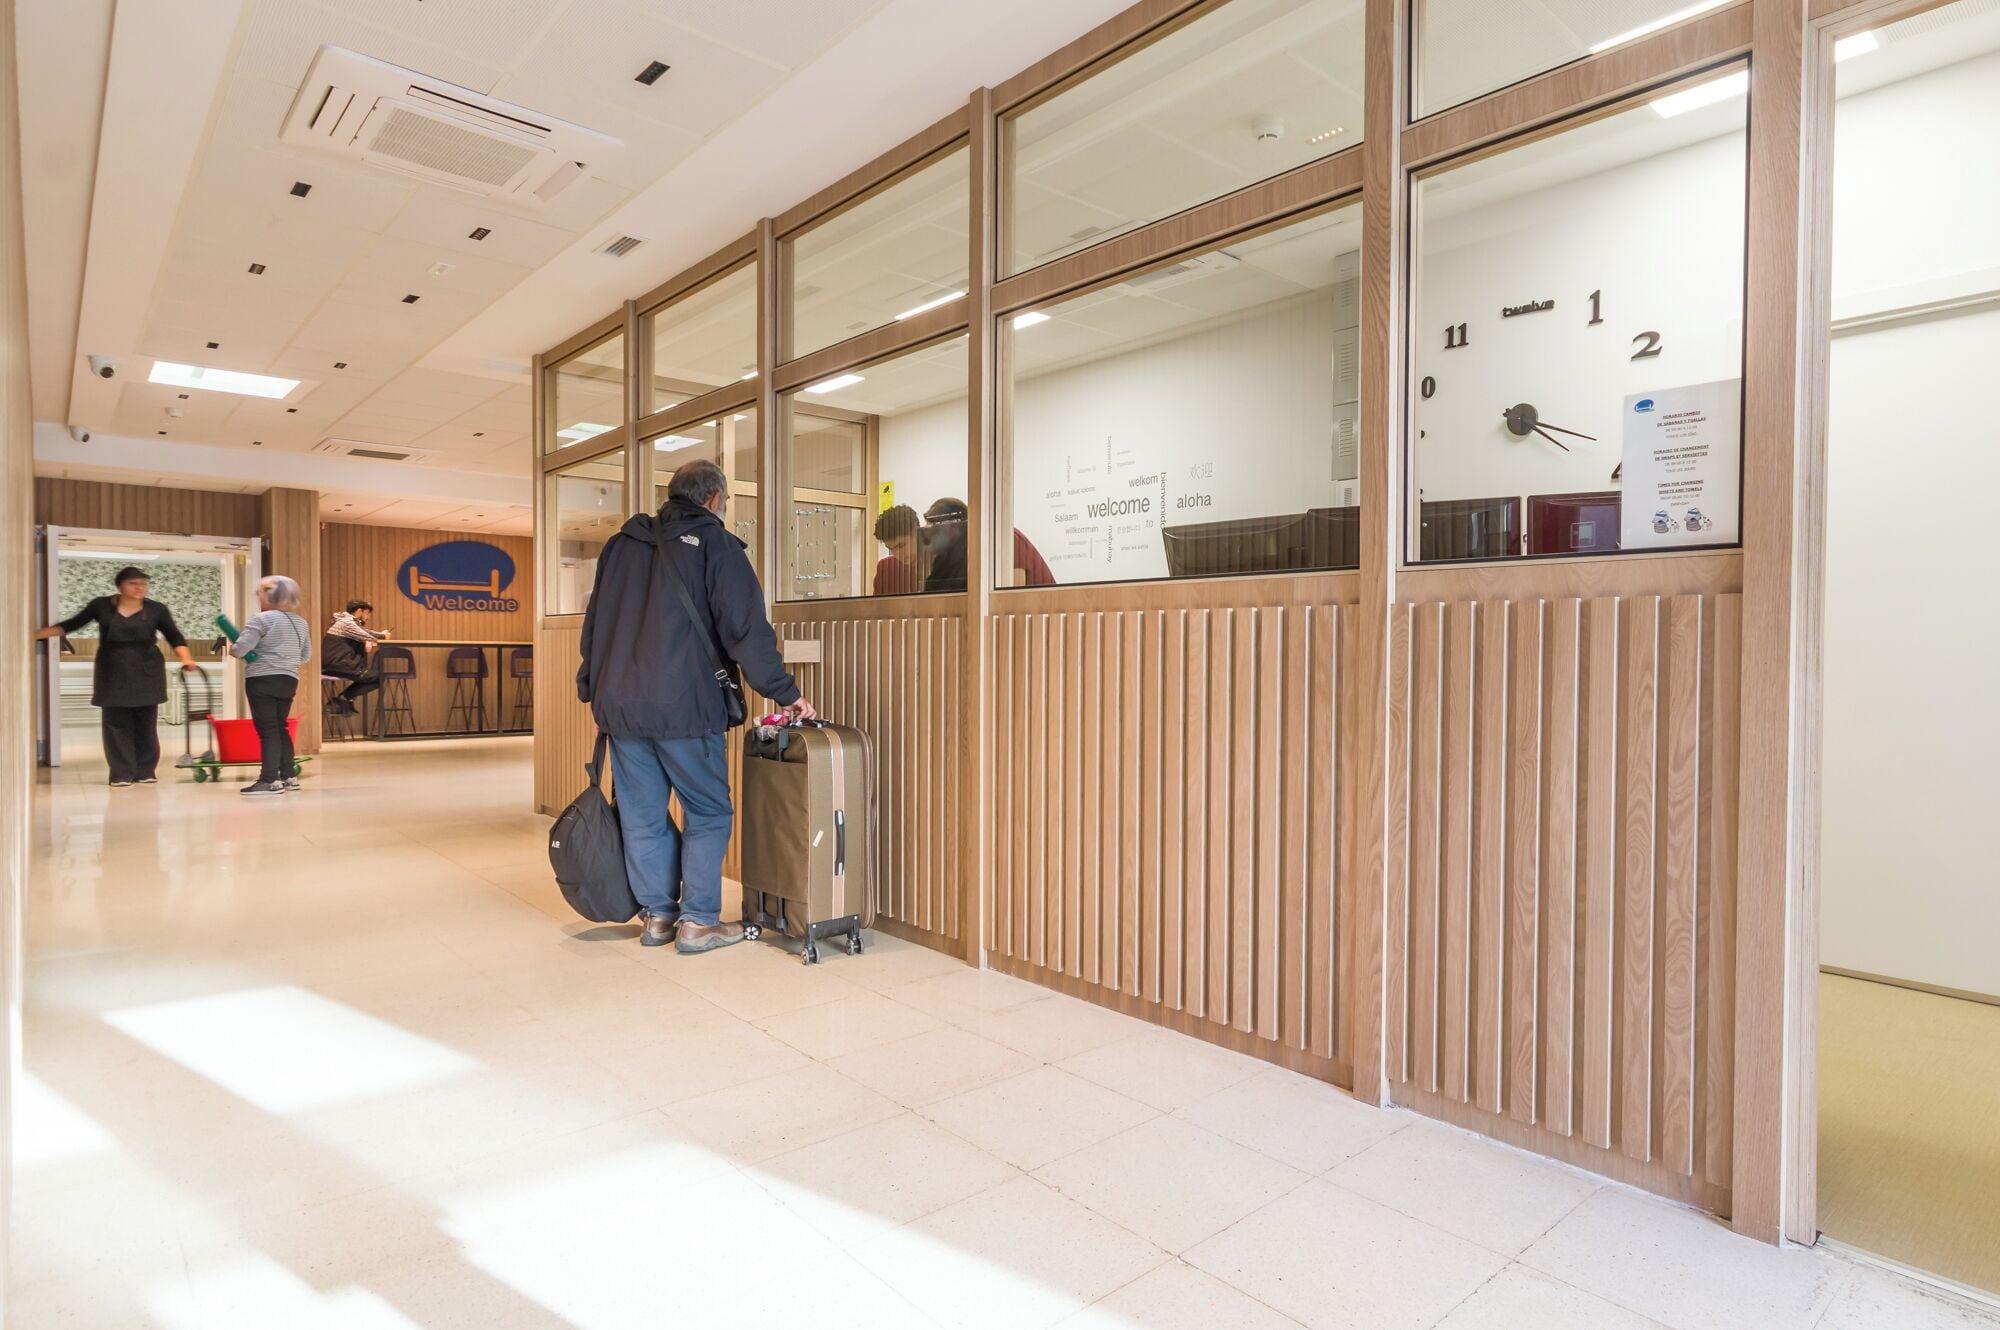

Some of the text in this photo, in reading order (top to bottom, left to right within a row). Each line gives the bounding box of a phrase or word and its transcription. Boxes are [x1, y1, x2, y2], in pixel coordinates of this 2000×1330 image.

[1588, 289, 1604, 325] 1
[1444, 323, 1469, 349] 11
[1631, 331, 1663, 361] 2
[1421, 376, 1436, 398] 0
[1128, 474, 1158, 488] welkom
[1088, 497, 1151, 518] welcome
[1176, 493, 1212, 509] aloha
[1054, 513, 1079, 523] Salaam
[425, 594, 518, 612] Welcome
